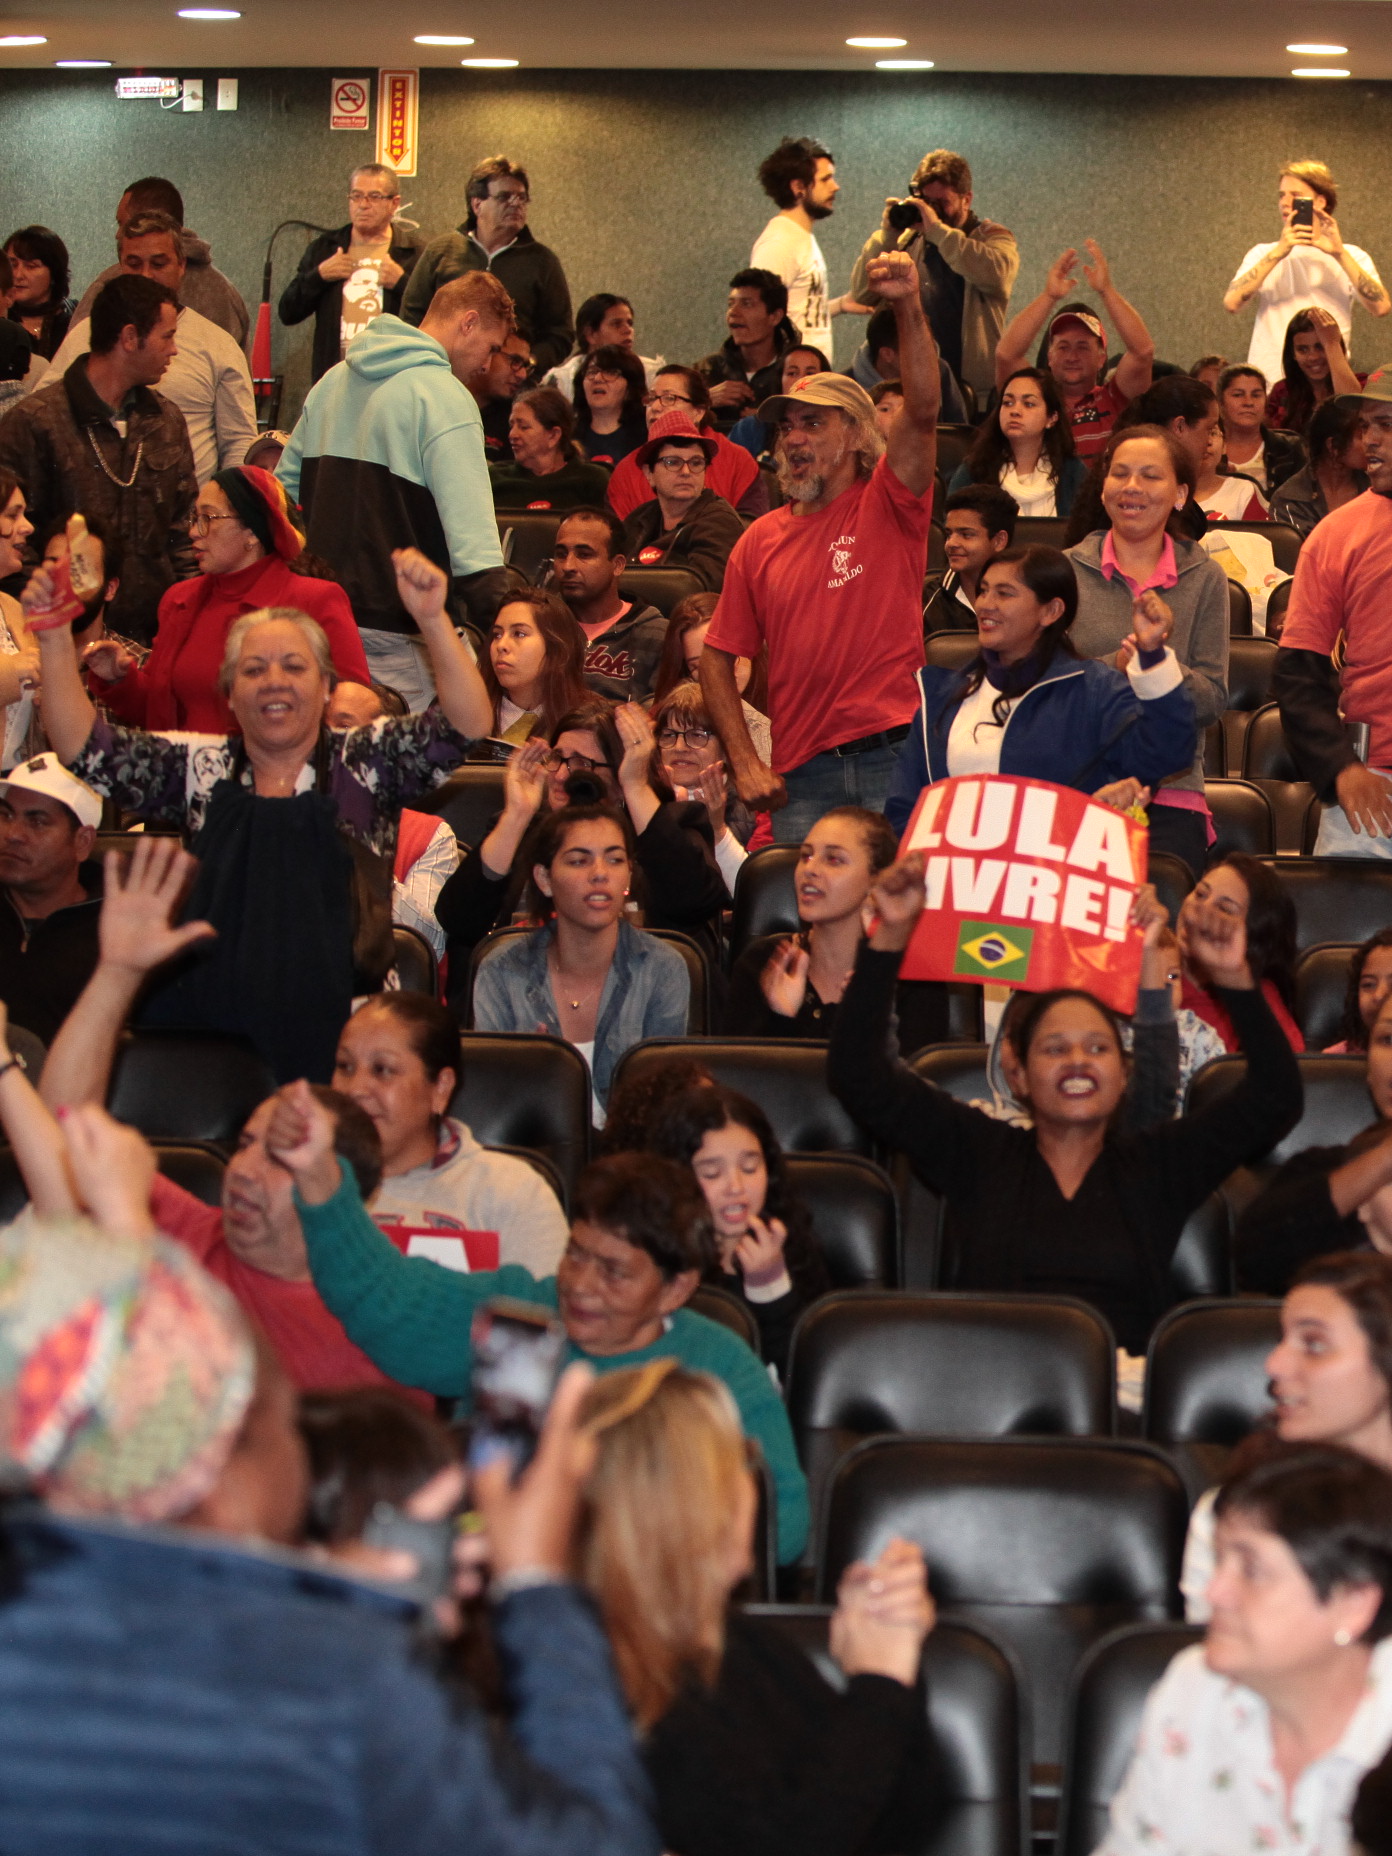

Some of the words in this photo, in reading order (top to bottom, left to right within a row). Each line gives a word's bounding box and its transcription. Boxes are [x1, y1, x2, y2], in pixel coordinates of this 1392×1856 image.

[391, 82, 403, 155] EXTINTOR
[907, 780, 1136, 885] LULA
[925, 855, 1134, 943] IVRE!
